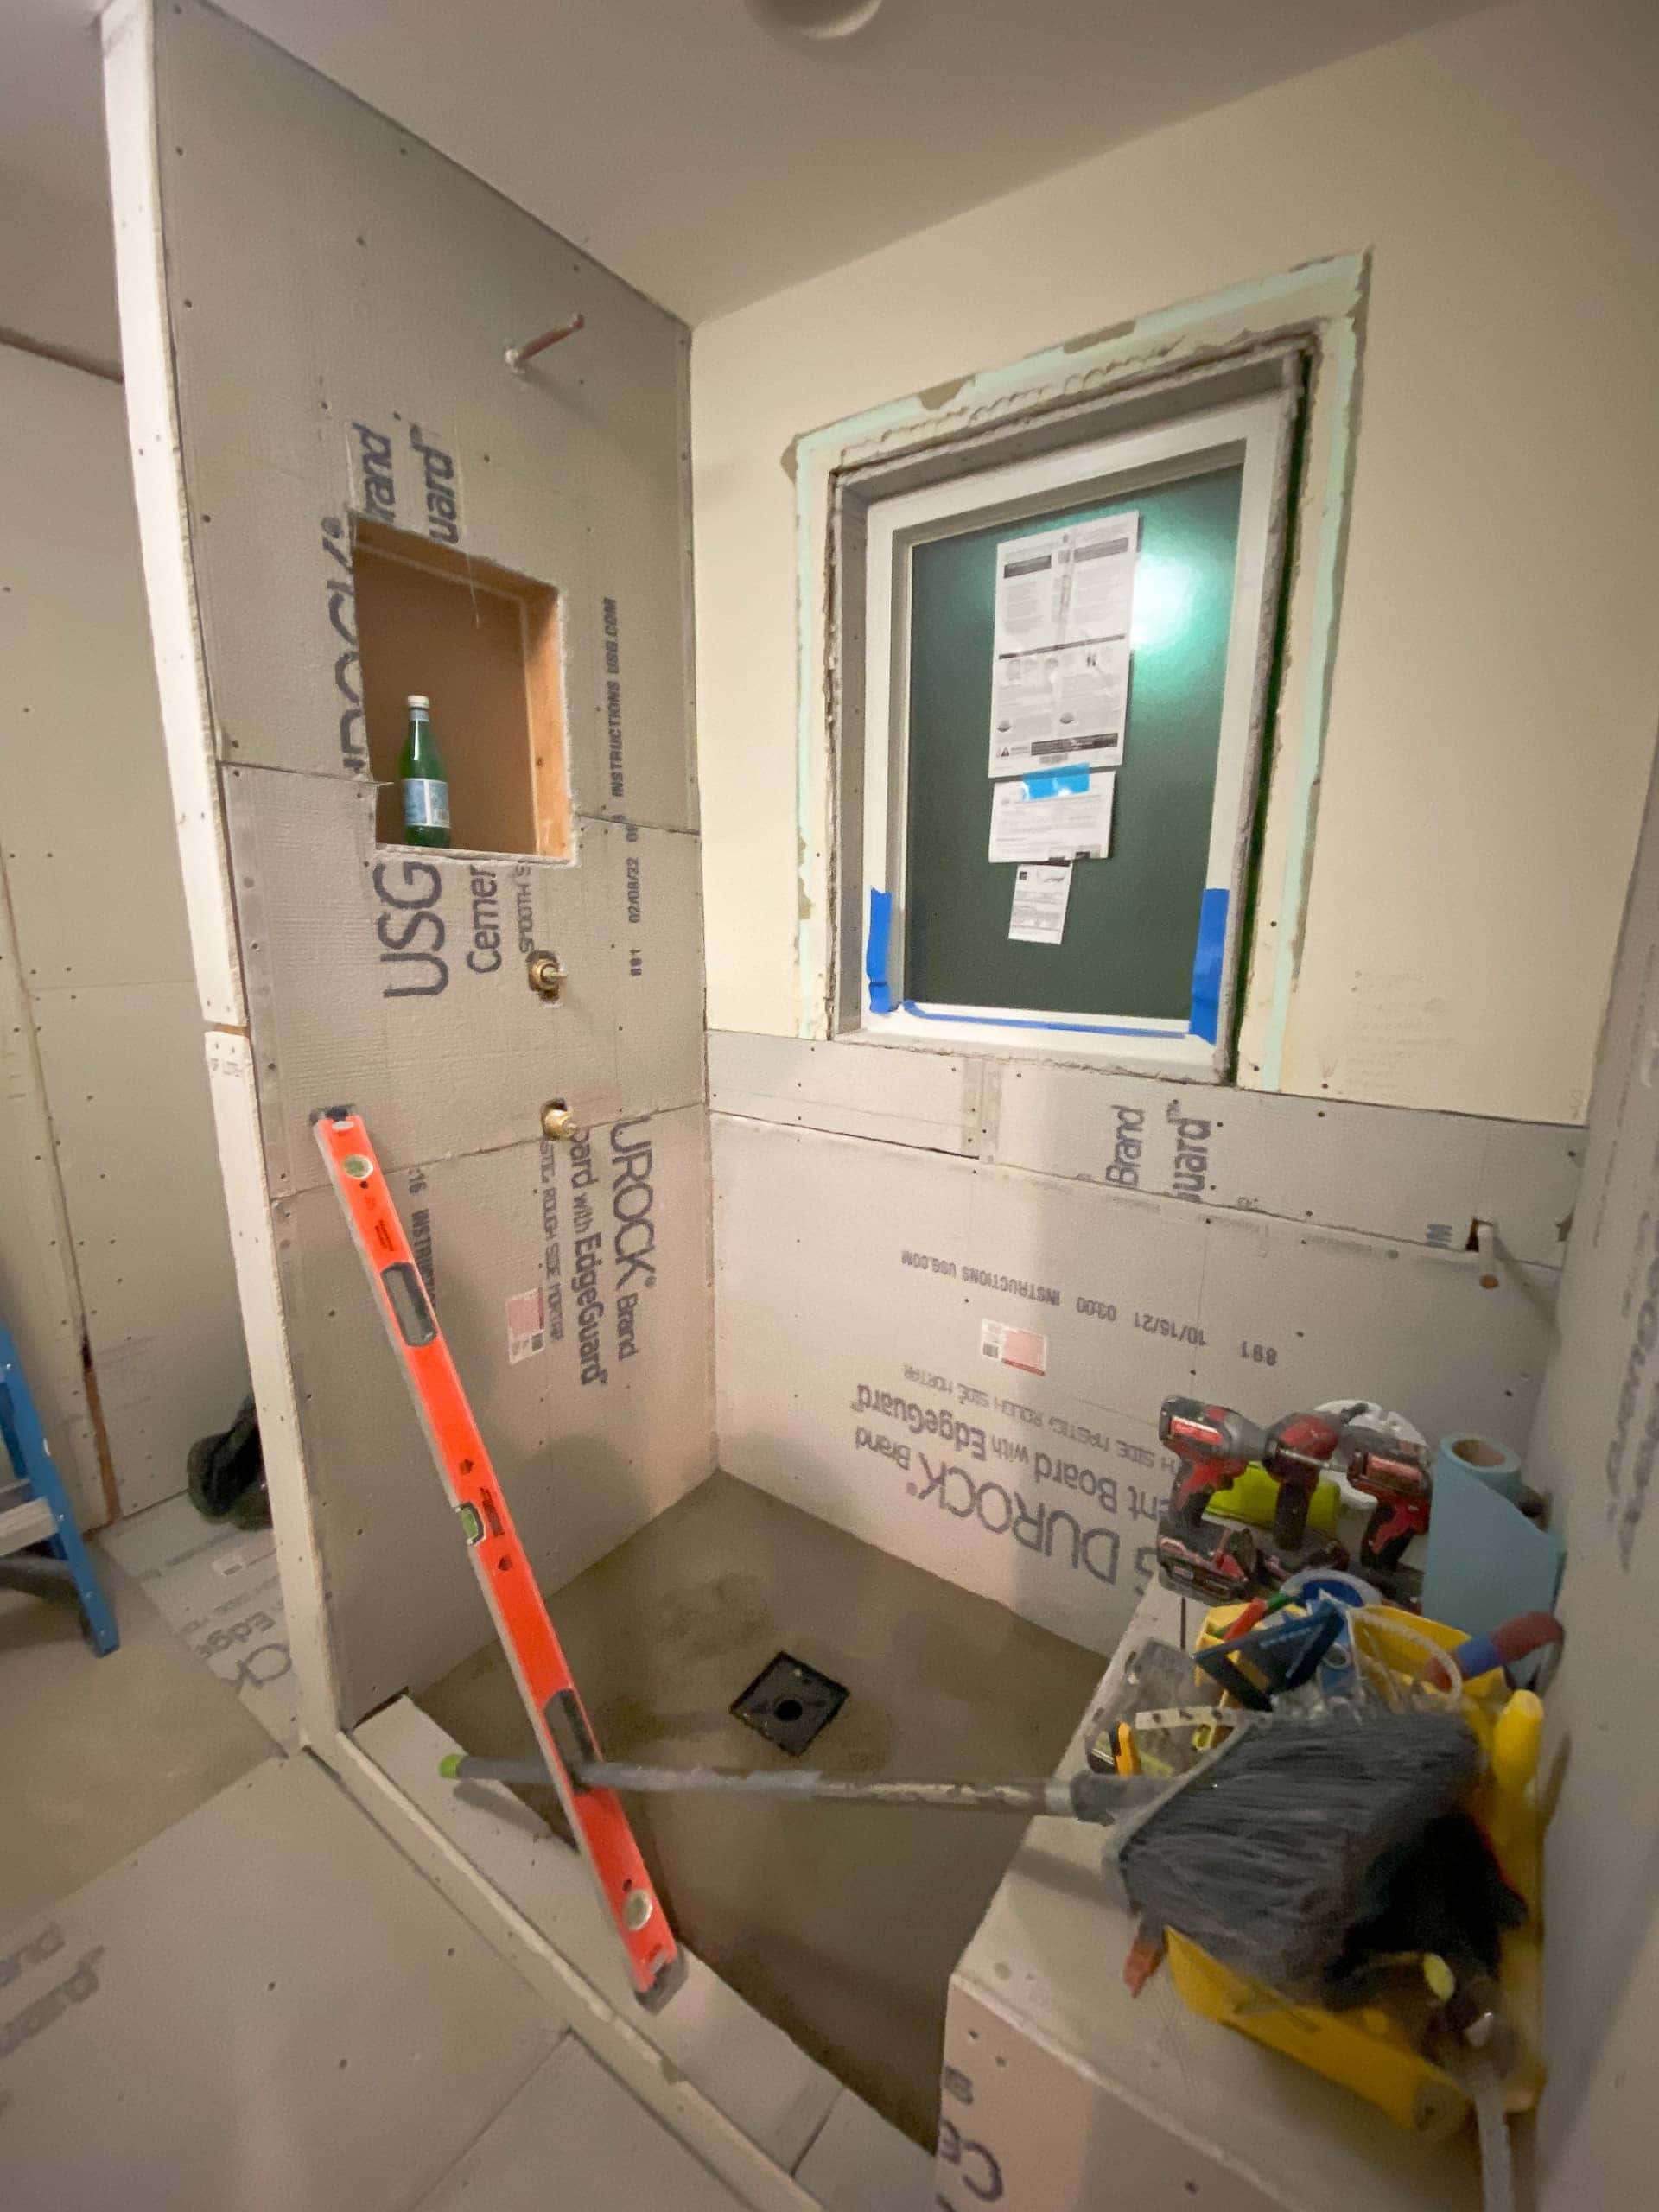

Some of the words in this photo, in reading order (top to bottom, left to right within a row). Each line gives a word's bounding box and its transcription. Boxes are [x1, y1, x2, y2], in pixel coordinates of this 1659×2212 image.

[607, 680, 625, 798] INSTRUCTIONS
[372, 861, 449, 999] USG
[1104, 1105, 1145, 1188] Brand
[572, 1192, 594, 1236] with
[960, 1264, 1061, 1307] INSTRUCTIONS
[616, 1291, 639, 1363] Brand
[1133, 1310, 1207, 1348] 10/15/21
[854, 1424, 912, 1471] Brand
[990, 1429, 1032, 1466] with
[1034, 1450, 1119, 1515] Board
